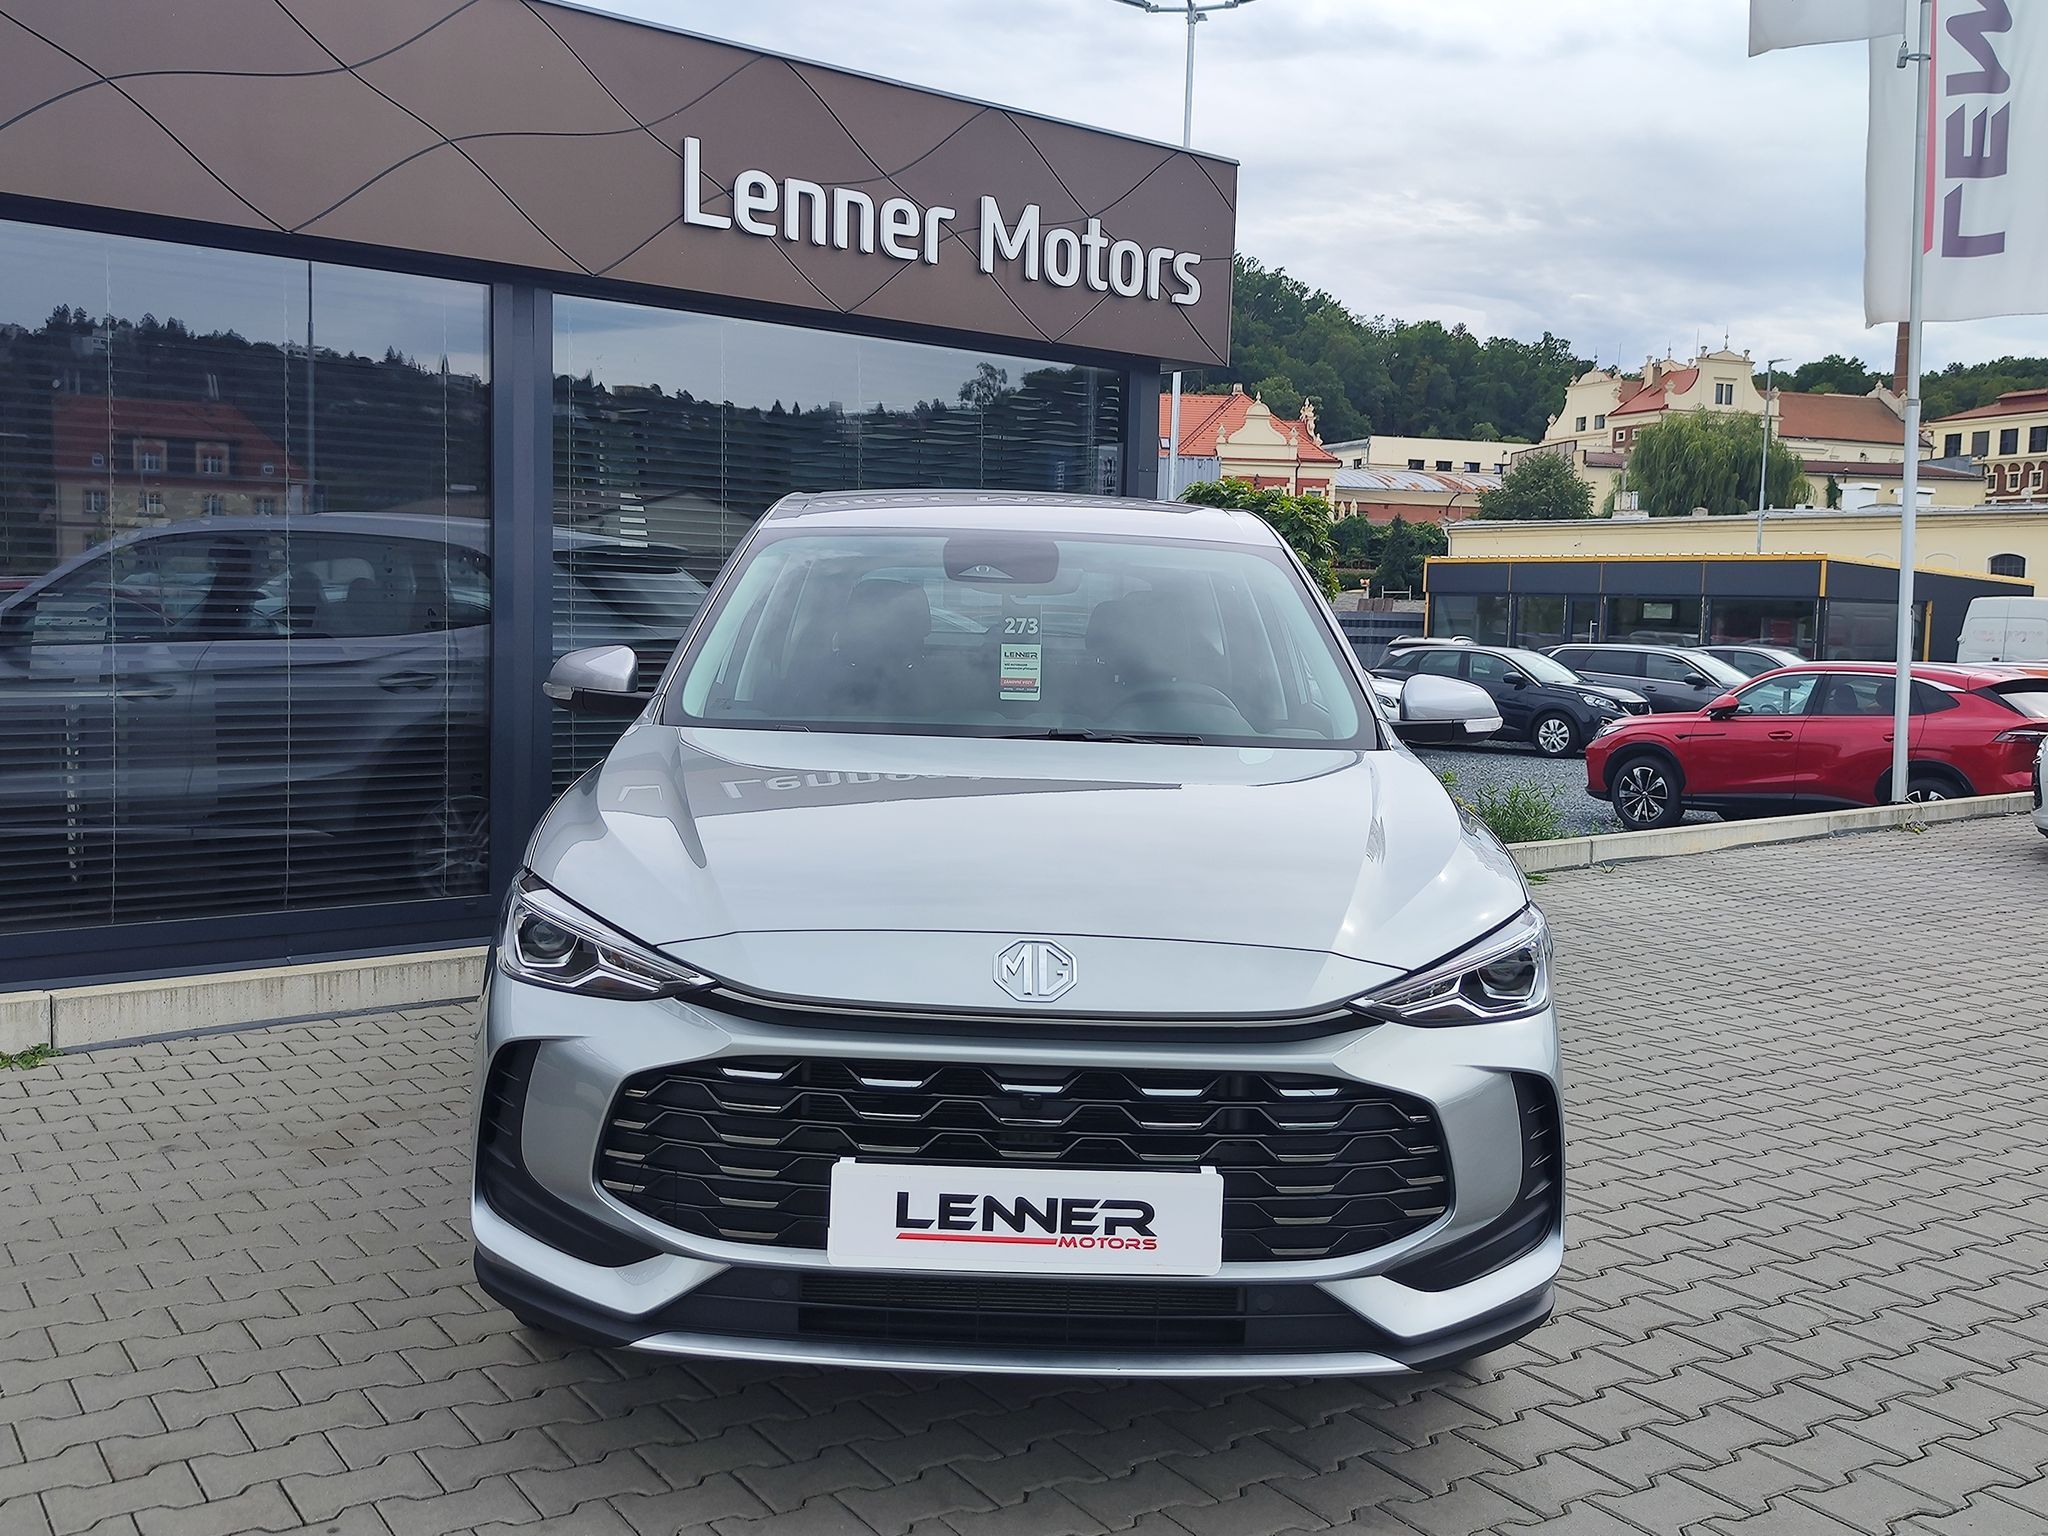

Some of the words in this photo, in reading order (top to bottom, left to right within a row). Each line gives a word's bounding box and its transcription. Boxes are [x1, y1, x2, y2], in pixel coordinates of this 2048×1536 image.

[682, 136, 956, 265] Lenner
[978, 194, 1202, 306] Motors
[1004, 617, 1038, 634] 273
[1004, 651, 1038, 659] LENNER
[999, 943, 1070, 997] MG
[895, 1191, 1158, 1237] LENNER
[1057, 1236, 1158, 1251] MOTORS
